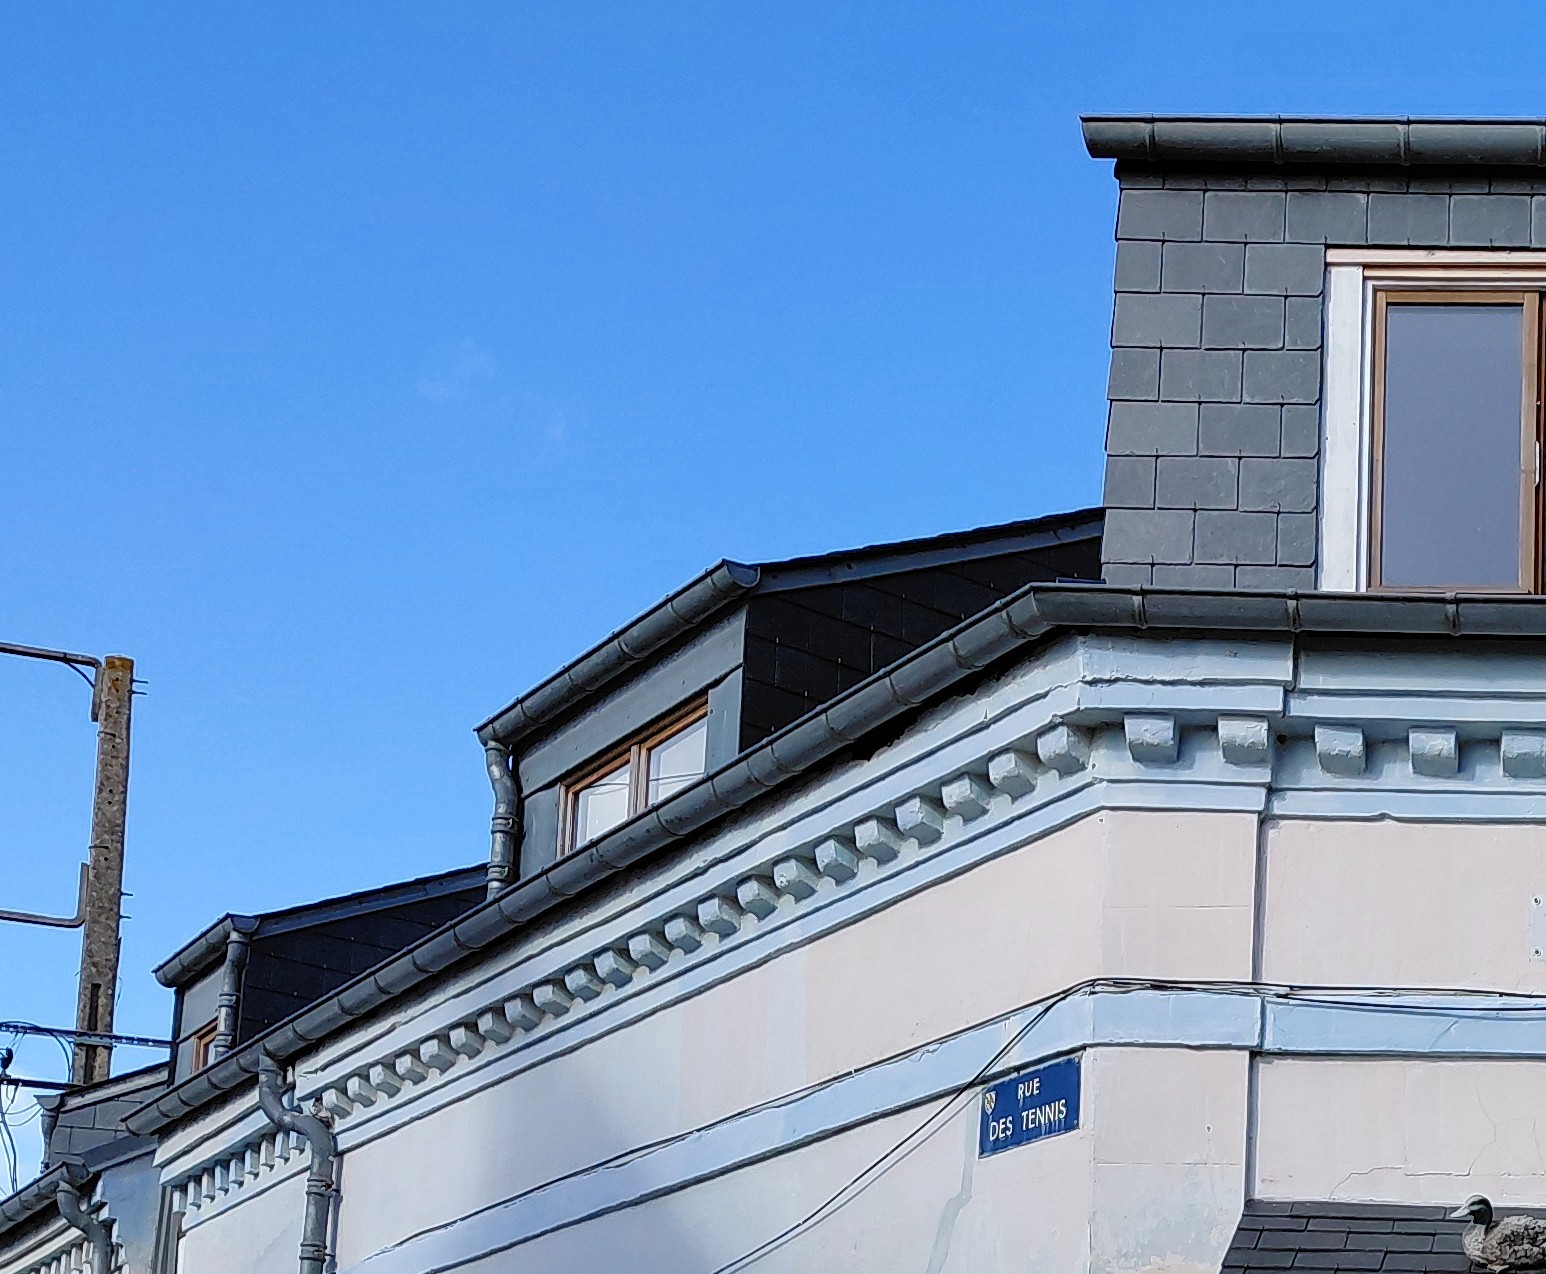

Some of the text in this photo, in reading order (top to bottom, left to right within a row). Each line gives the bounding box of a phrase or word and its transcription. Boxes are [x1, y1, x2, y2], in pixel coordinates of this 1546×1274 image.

[1017, 1077, 1040, 1100] RUE
[989, 1098, 1067, 1141] DES TENNIS
